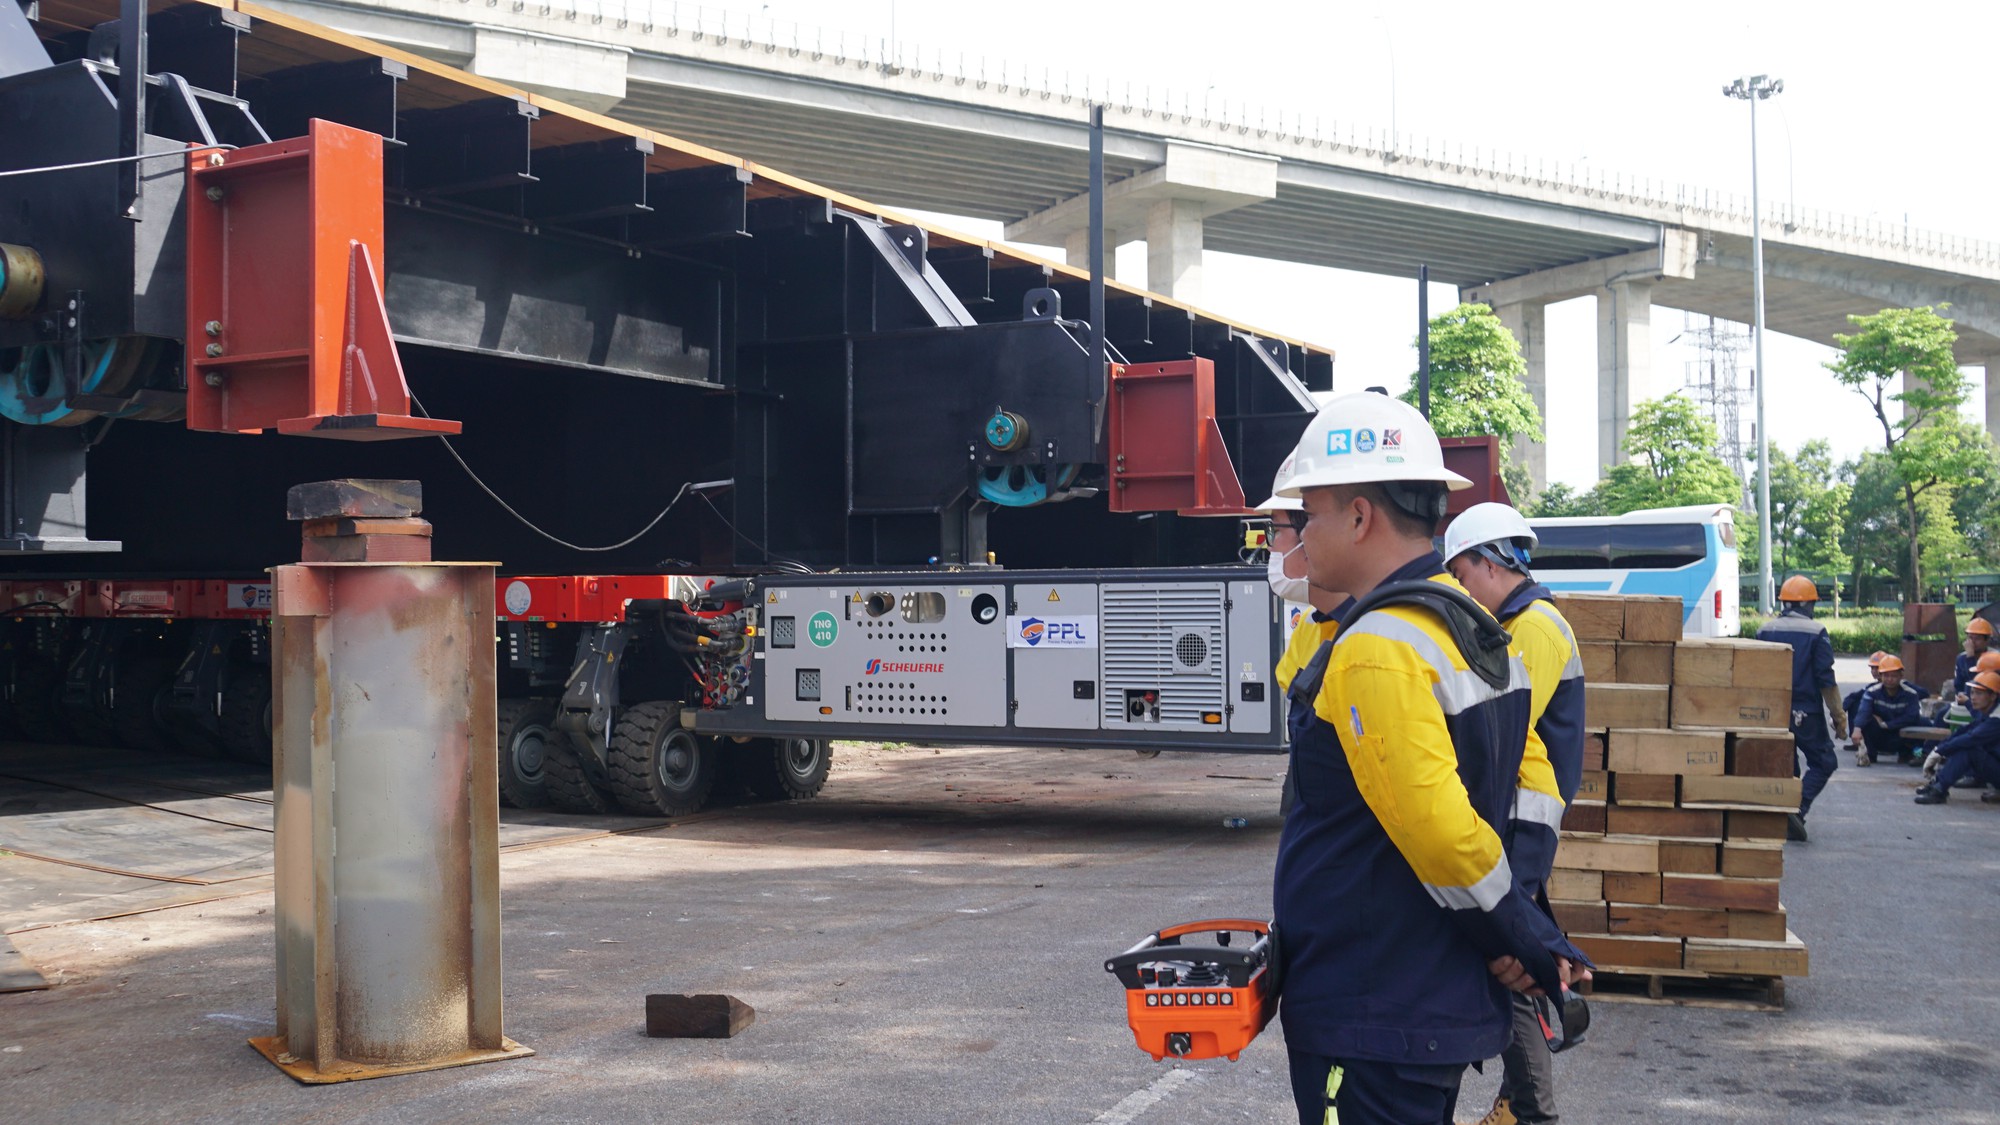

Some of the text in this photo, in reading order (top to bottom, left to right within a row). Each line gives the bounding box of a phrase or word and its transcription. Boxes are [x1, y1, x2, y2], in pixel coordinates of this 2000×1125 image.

[1330, 433, 1347, 452] R
[258, 589, 271, 602] PP
[813, 619, 832, 629] TNG
[815, 631, 832, 640] 410
[1048, 623, 1086, 639] PPL
[882, 662, 945, 673] SCHEUERLE
